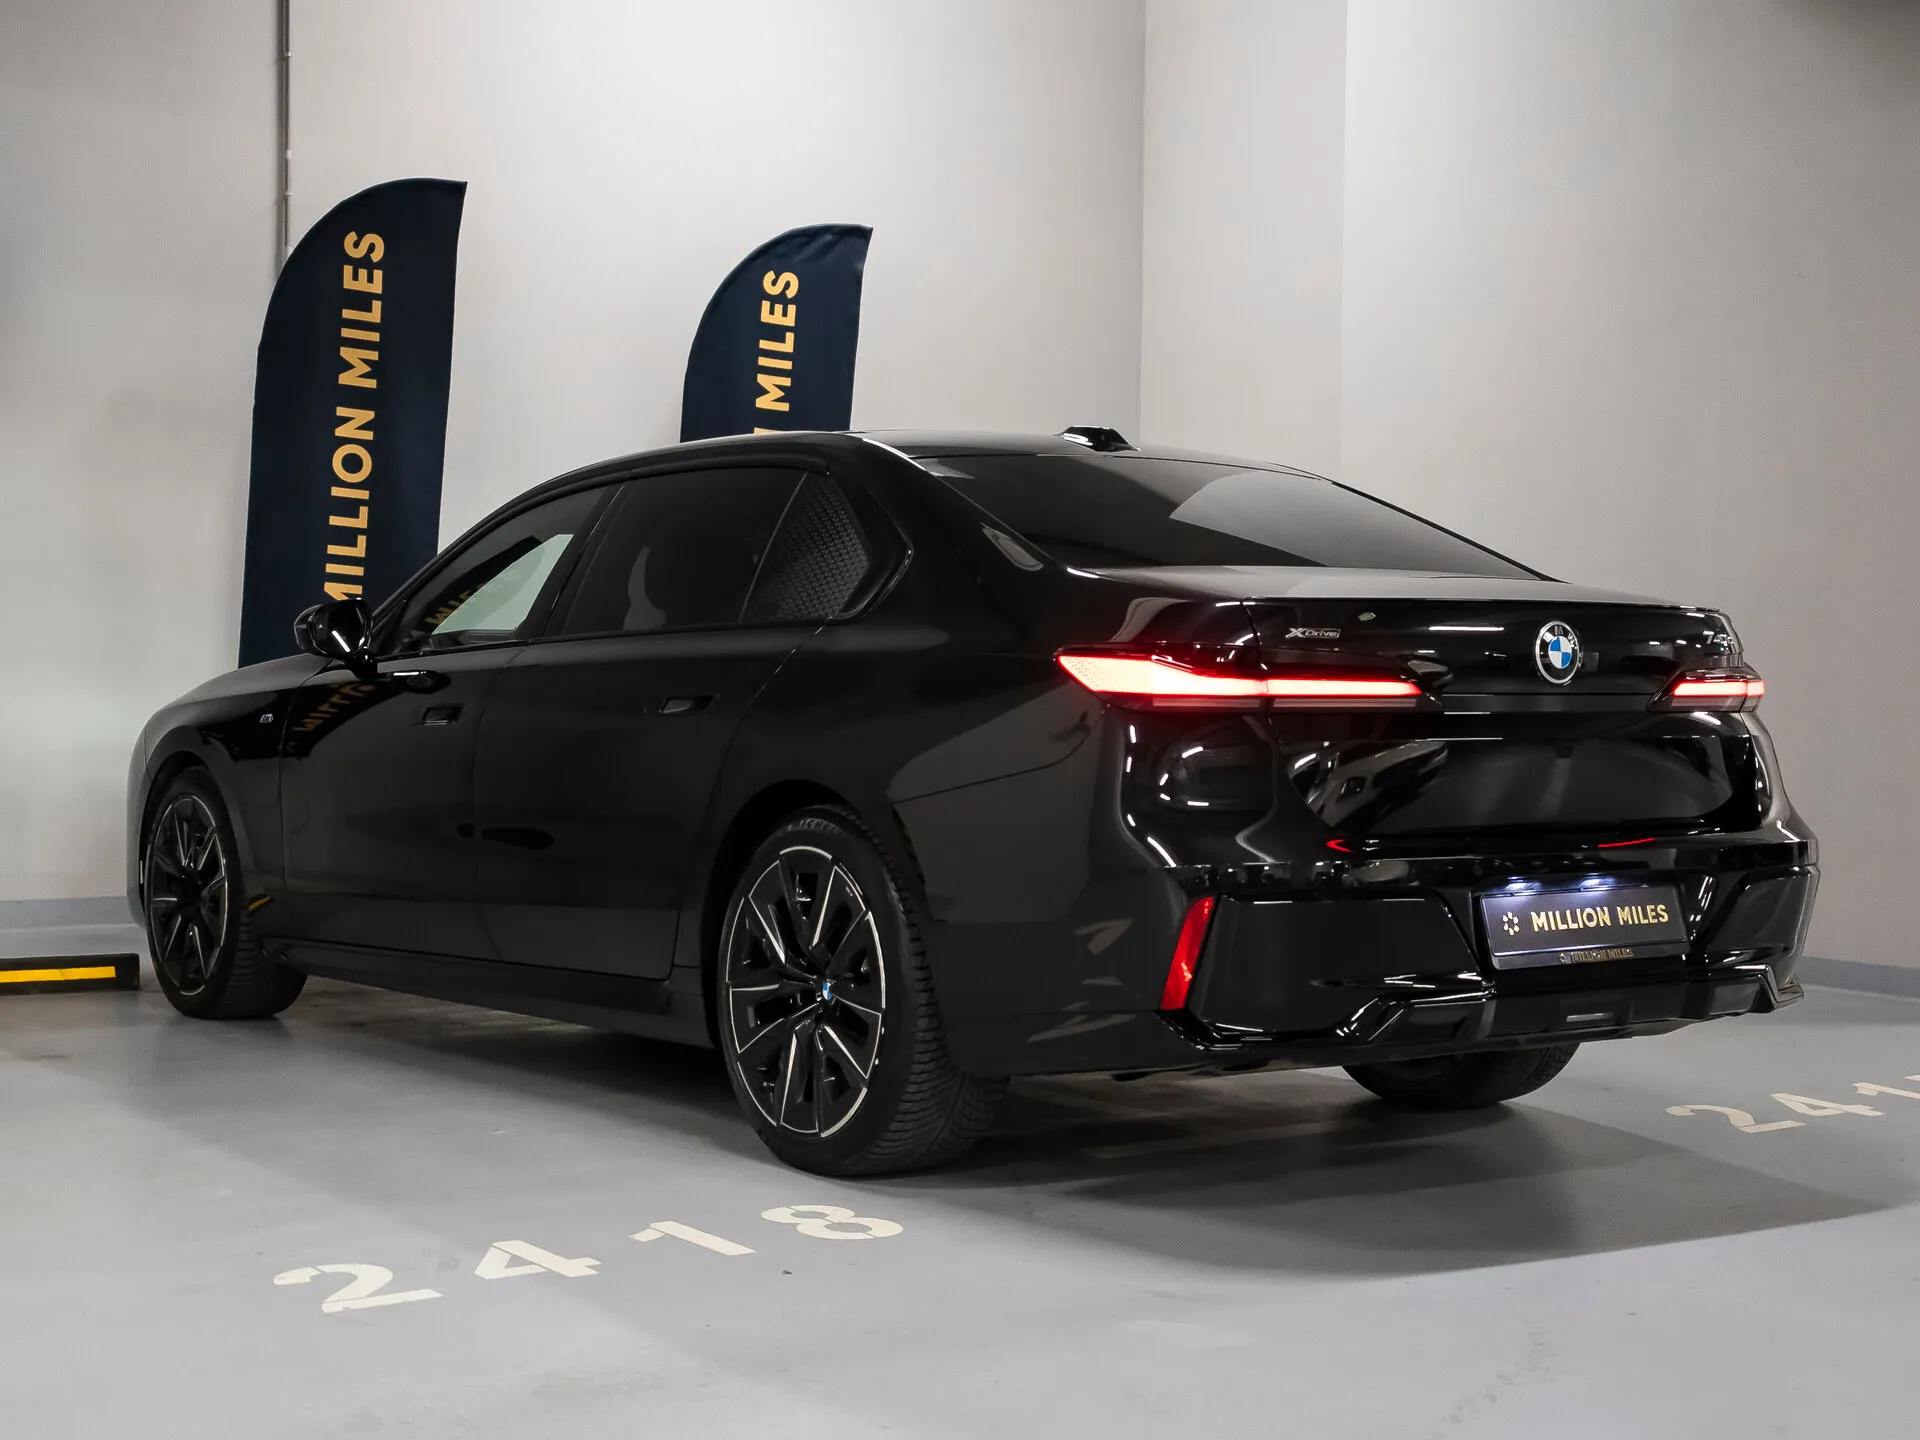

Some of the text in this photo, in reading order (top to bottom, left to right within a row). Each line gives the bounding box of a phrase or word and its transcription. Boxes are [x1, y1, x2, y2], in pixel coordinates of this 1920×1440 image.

[339, 231, 385, 389] MILES
[755, 270, 799, 412] MILES
[1530, 904, 1669, 932] MILLION MILES
[1664, 1074, 1920, 1133] 241
[273, 1205, 904, 1314] 2418
